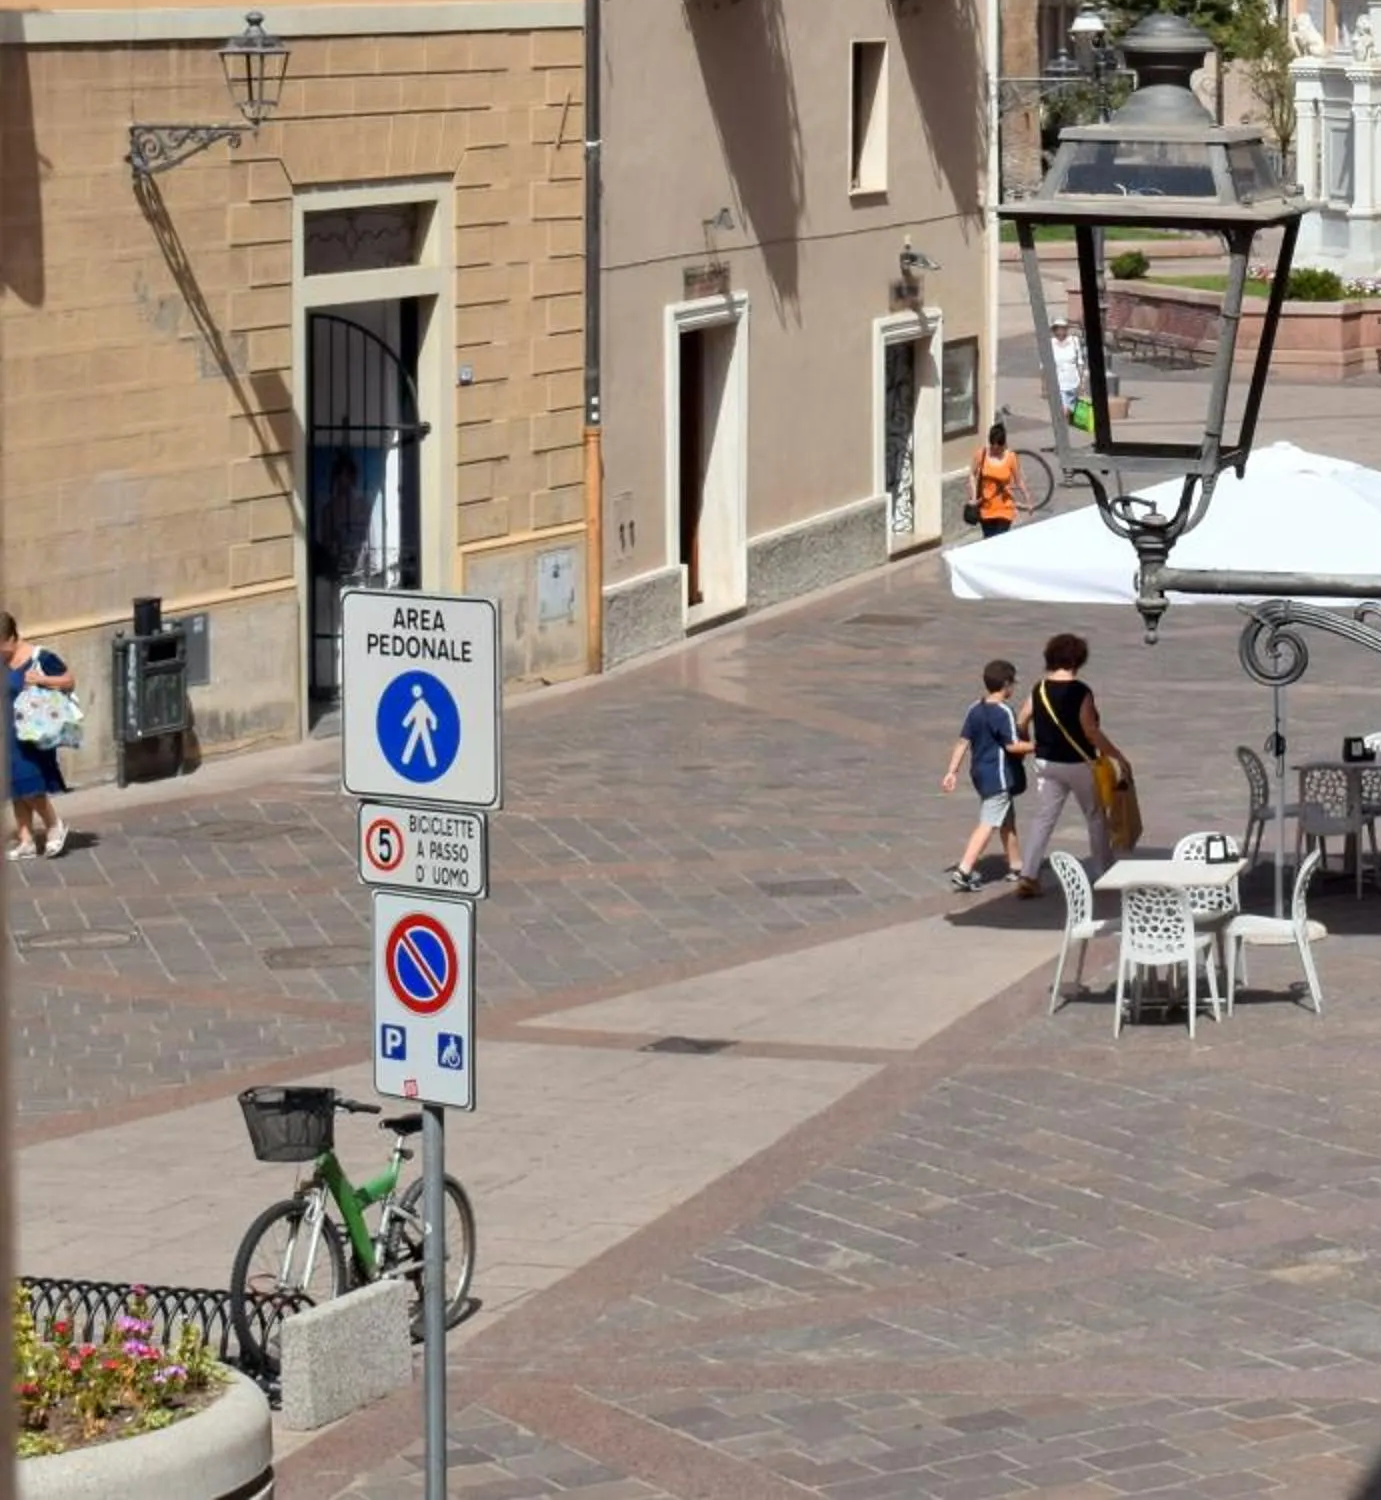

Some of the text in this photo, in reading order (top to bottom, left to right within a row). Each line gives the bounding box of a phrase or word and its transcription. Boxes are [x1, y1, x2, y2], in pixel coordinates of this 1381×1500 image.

[393, 607, 446, 632] AREA
[366, 633, 473, 663] PEDONALE
[409, 814, 475, 839] BICICLETTE
[379, 827, 392, 862] 5
[416, 840, 469, 863] A PASSO
[432, 866, 469, 887] UOMO
[385, 1027, 403, 1055] P
